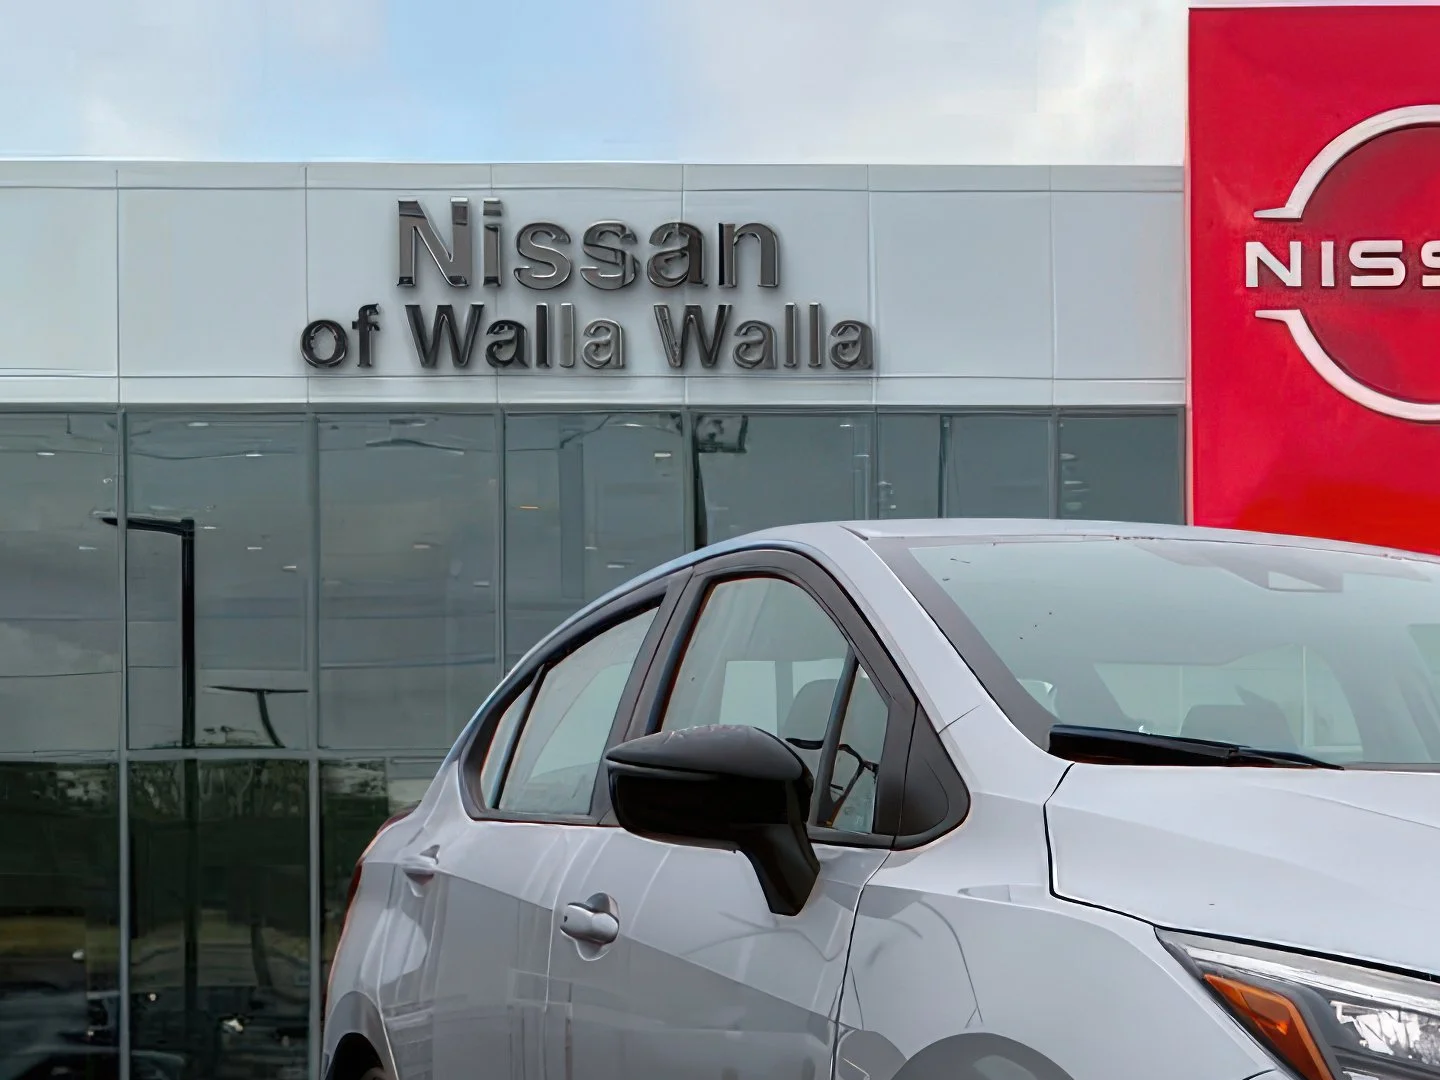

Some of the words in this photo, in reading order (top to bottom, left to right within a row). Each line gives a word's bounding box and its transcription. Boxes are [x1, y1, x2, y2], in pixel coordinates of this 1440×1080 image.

[398, 197, 781, 288] Nissan
[300, 303, 381, 369] of
[405, 303, 626, 369] Walla
[654, 303, 875, 369] Walla
